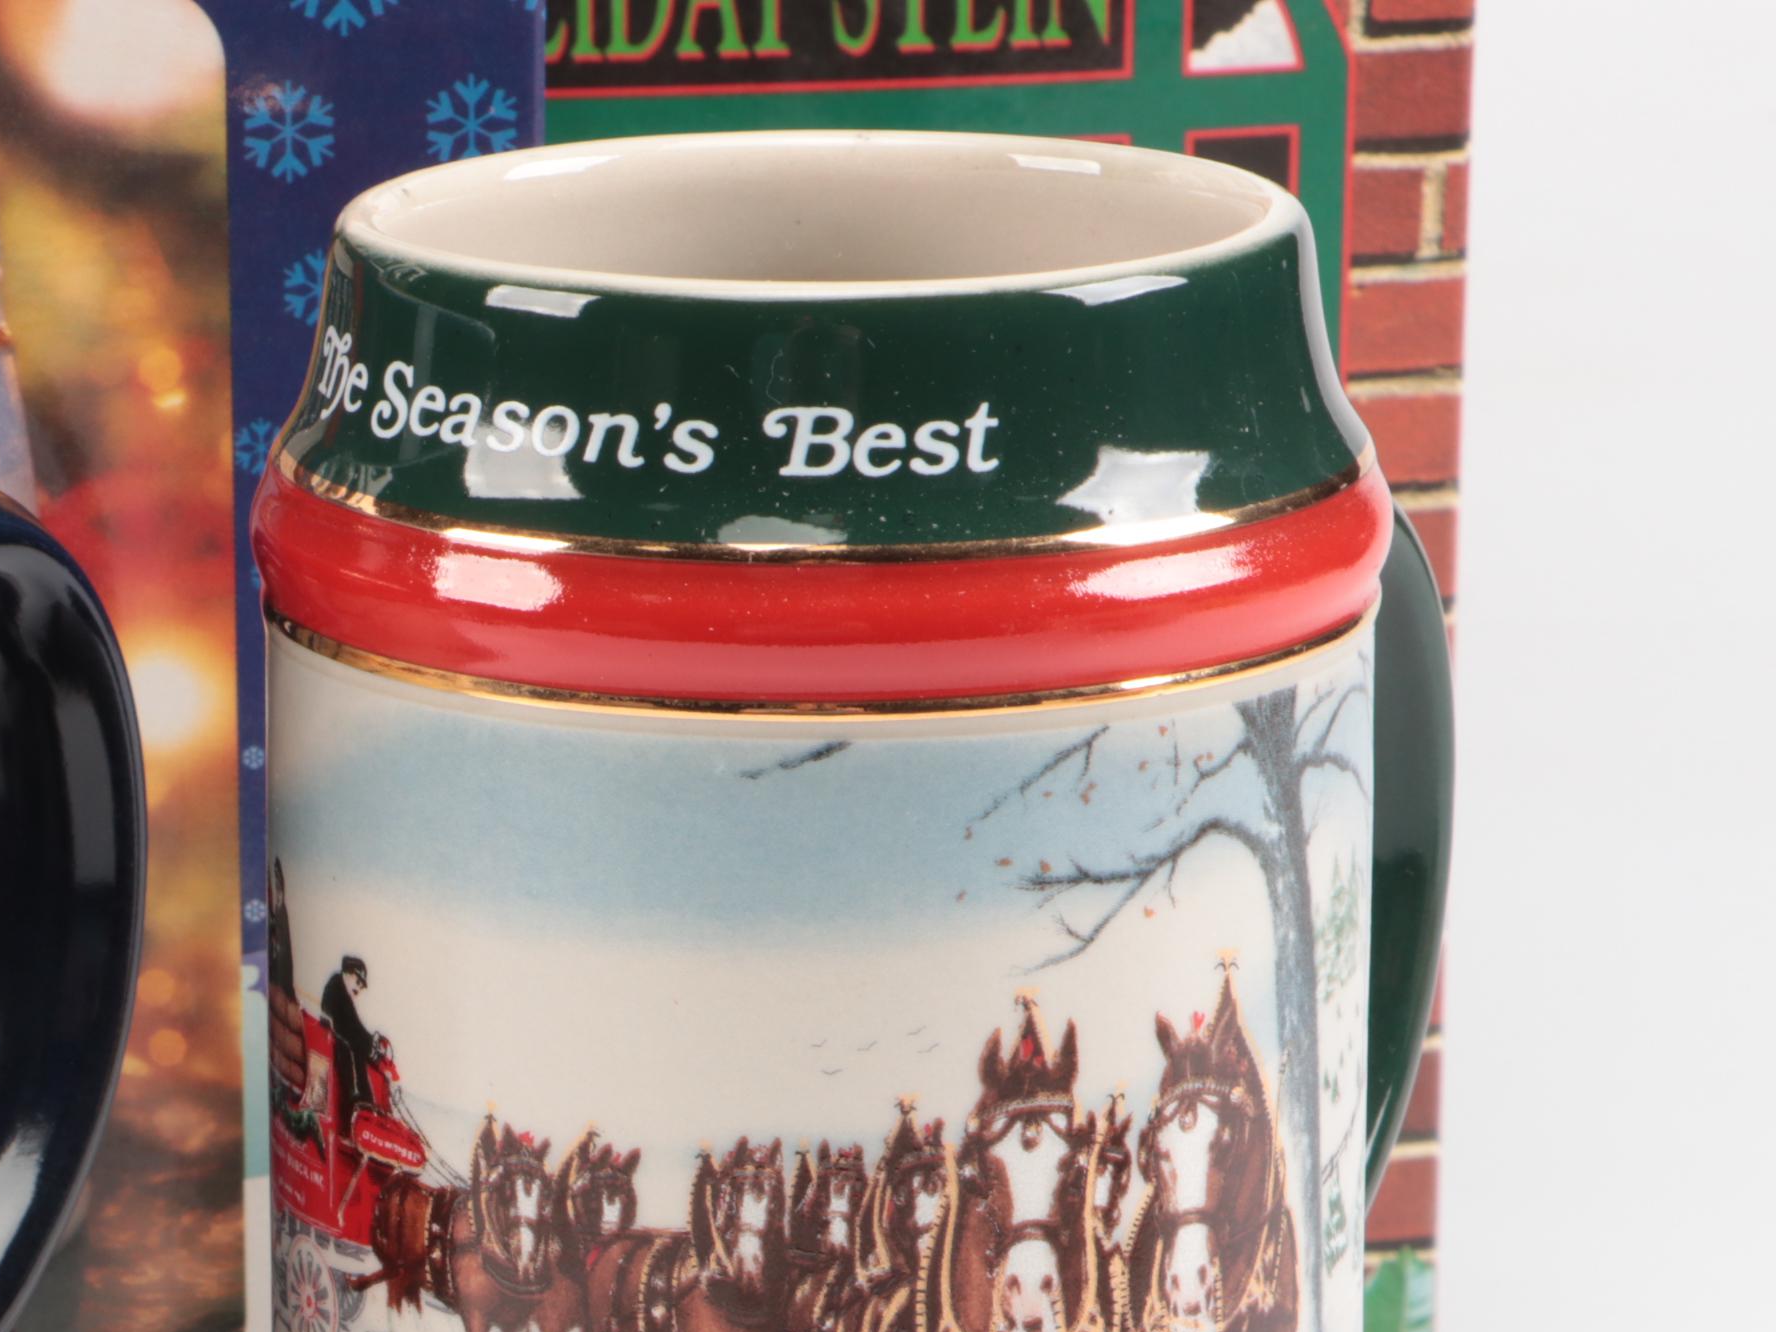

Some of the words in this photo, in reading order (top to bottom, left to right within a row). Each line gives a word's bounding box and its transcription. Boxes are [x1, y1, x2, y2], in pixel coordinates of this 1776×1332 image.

[318, 324, 369, 420] The
[370, 360, 719, 474] Season's
[762, 401, 1000, 478] Best
